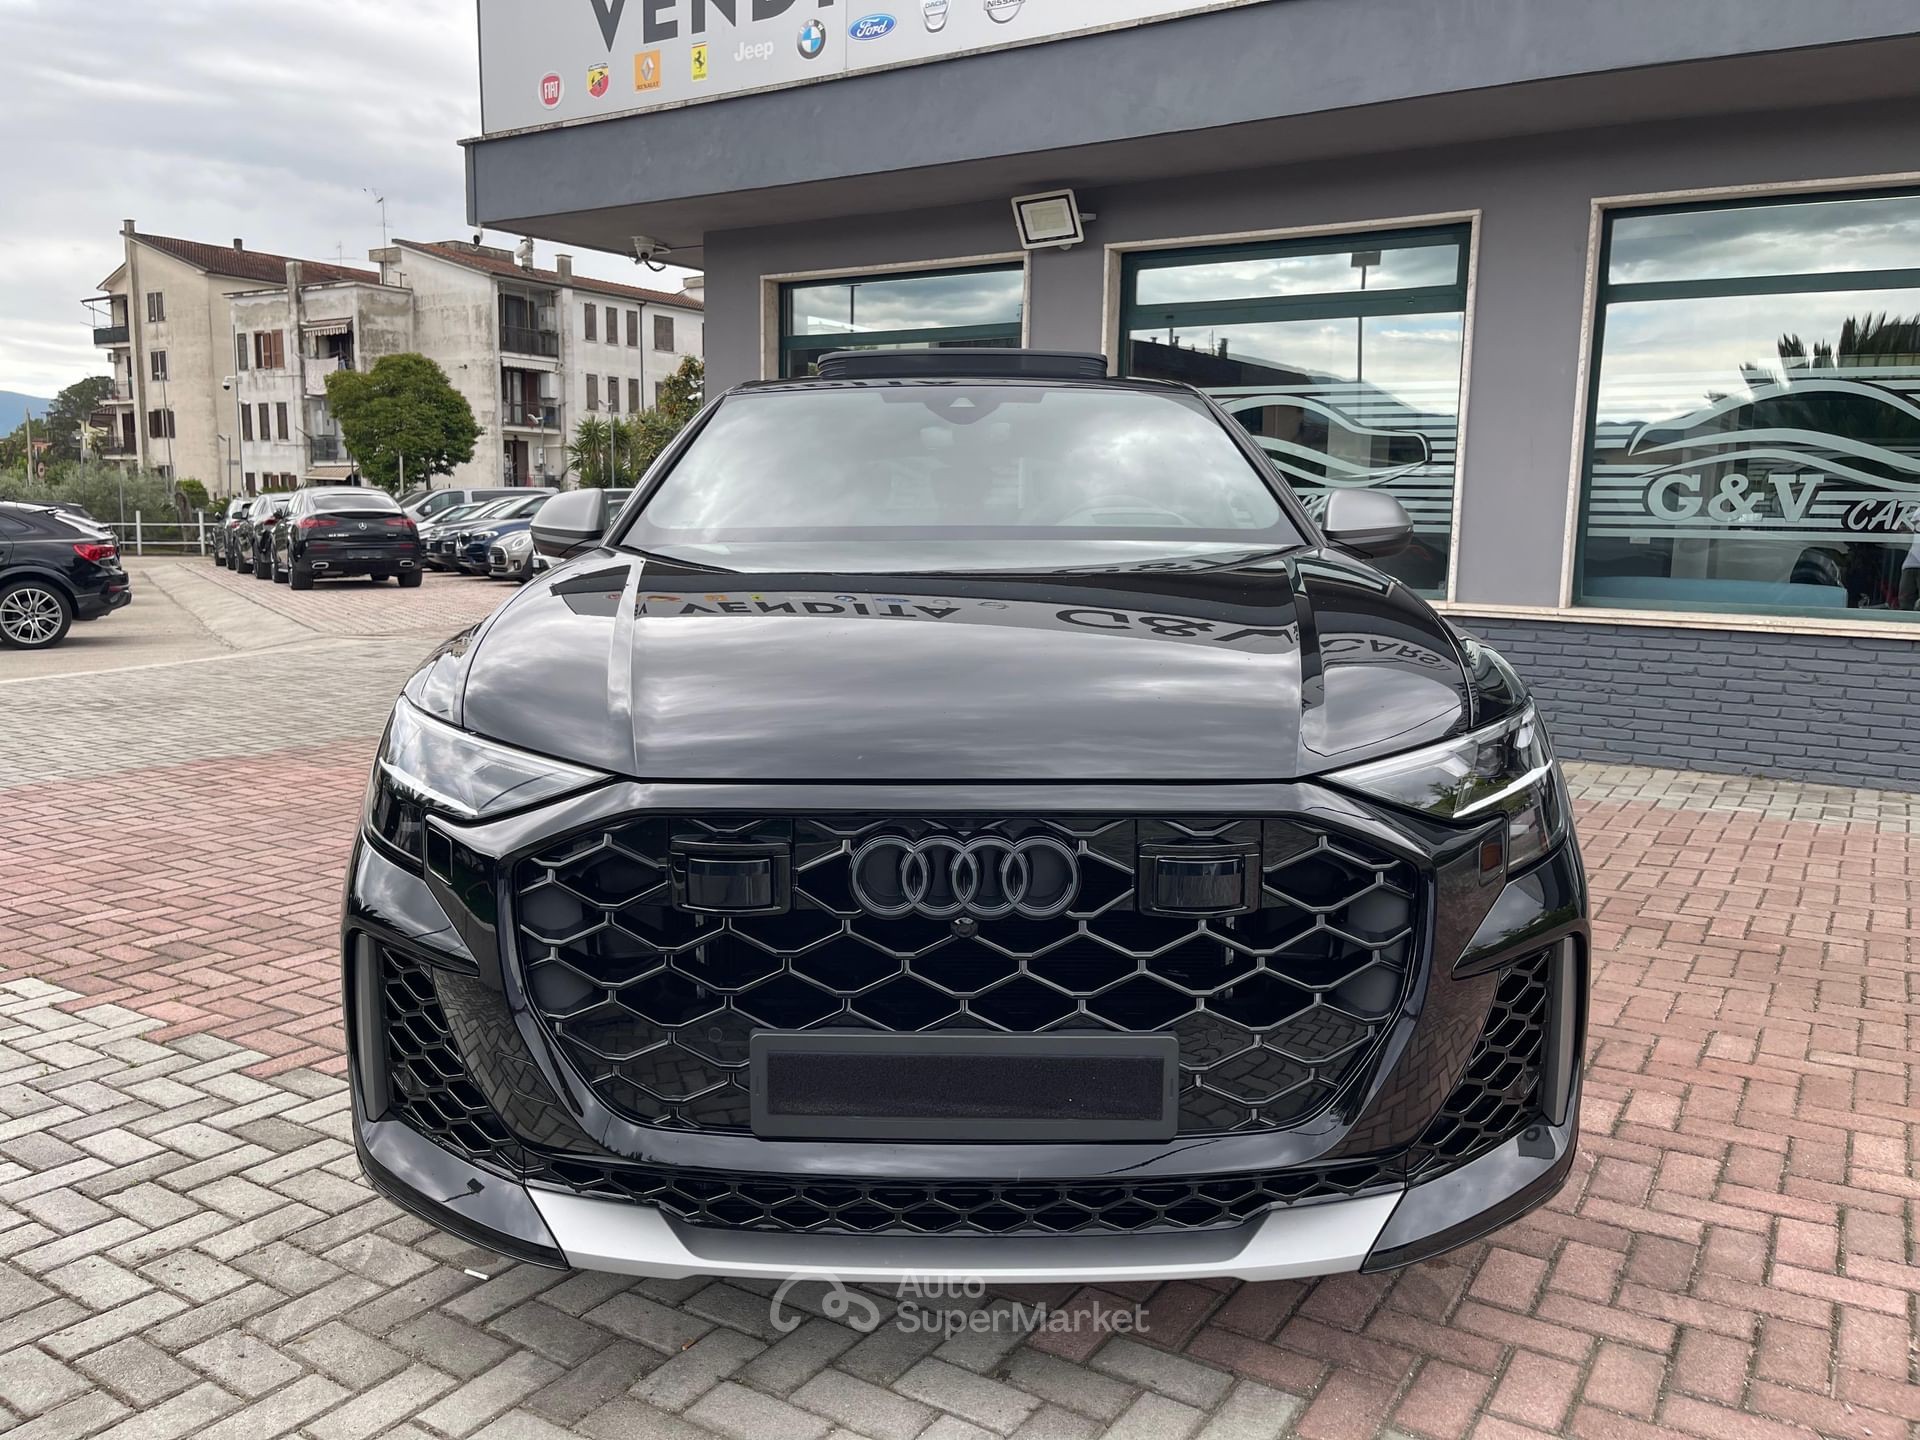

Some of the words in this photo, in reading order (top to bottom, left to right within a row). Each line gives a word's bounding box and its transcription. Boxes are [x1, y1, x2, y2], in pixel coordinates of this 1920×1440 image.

[856, 18, 888, 37] Ford
[734, 41, 774, 61] Jeep
[544, 81, 559, 99] FIAT
[1647, 474, 1825, 523] G&V
